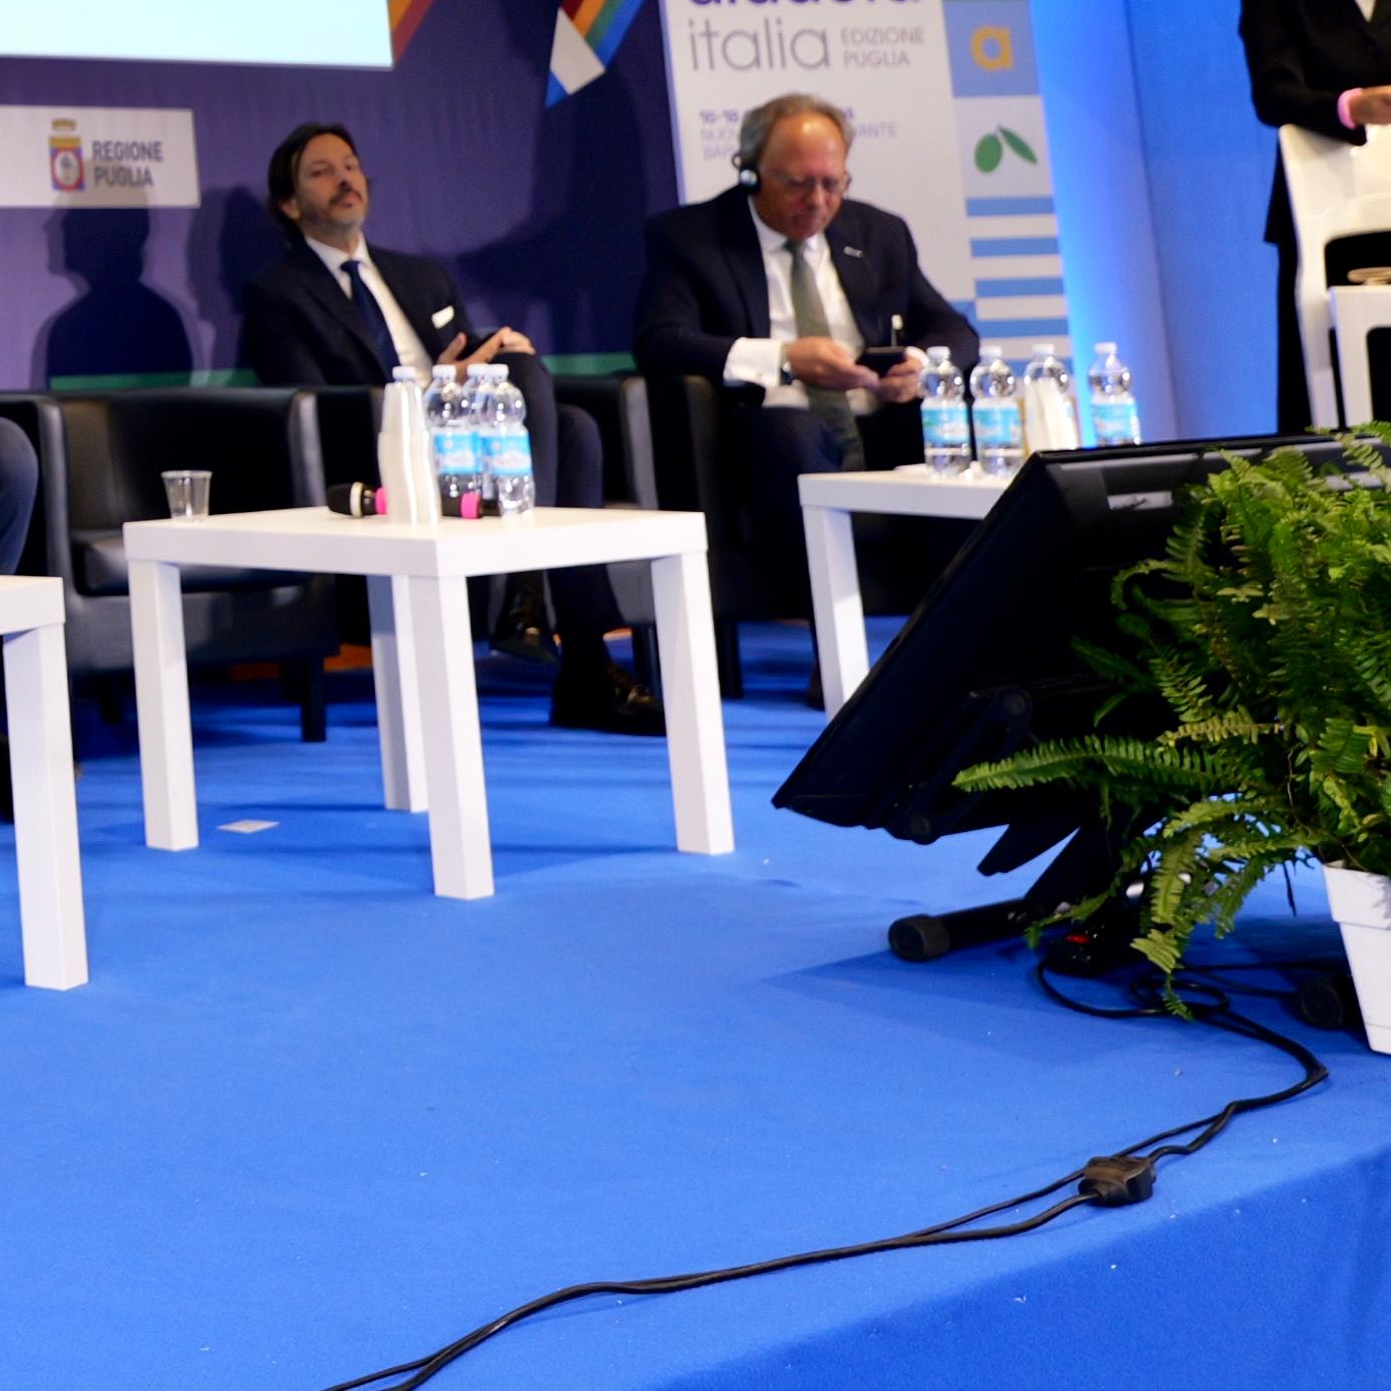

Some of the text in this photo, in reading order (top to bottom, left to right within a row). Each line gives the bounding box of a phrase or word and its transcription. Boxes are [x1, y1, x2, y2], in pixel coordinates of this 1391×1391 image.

[689, 17, 830, 71] italia
[841, 26, 926, 46] EDIZIONE
[843, 49, 910, 68] PUGLIA
[92, 140, 164, 162] REGIONE
[93, 165, 154, 187] PUGLIA
